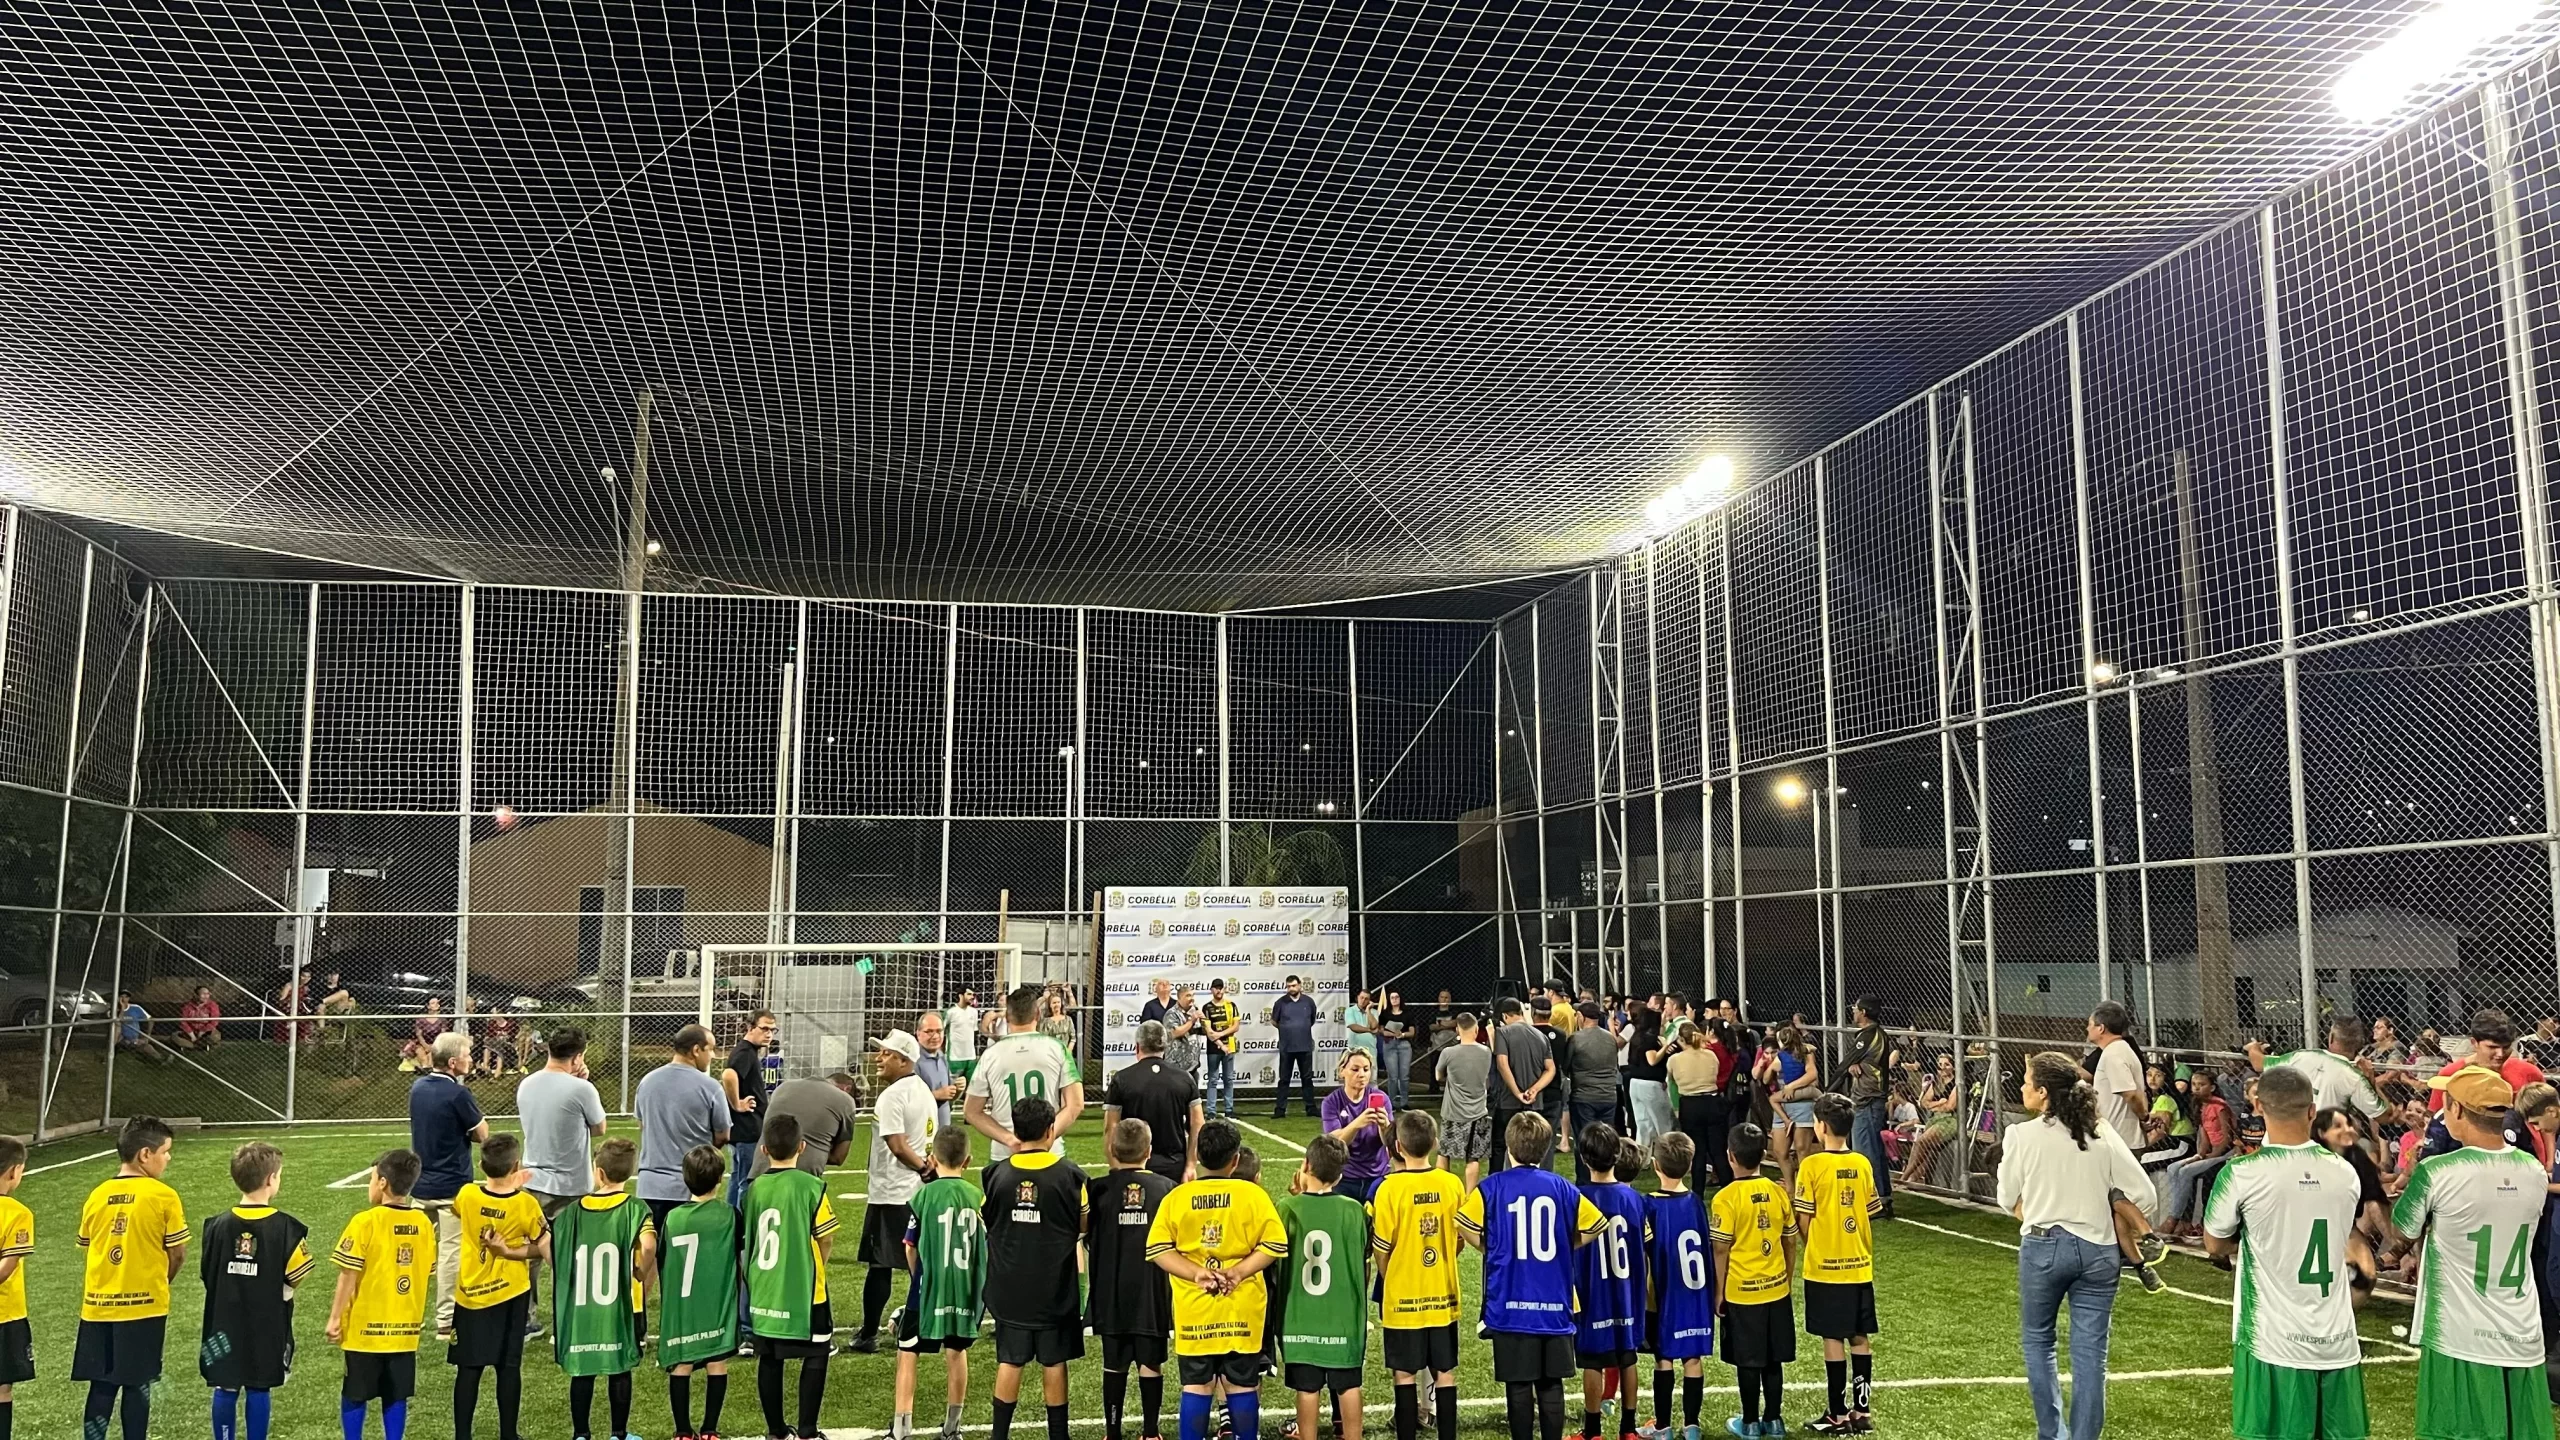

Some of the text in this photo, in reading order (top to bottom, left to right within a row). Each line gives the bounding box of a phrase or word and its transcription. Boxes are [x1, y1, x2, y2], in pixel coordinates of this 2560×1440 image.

[1128, 894, 1176, 904] CORBÉLIA
[1203, 894, 1251, 904] CORBÉLIA
[1278, 893, 1325, 904] CORBÉLIA
[1104, 922, 1140, 932] RBÉLIA
[1168, 922, 1216, 932] CORBÉLIA
[1243, 922, 1291, 932] CORBÉLIA
[1127, 952, 1176, 963] CORBÉLIA
[1203, 952, 1251, 962] CORBÉLIA
[1278, 951, 1325, 961] CORBÉLIA
[1118, 1211, 1148, 1226] CORBÉLIA
[1507, 1195, 1557, 1262] 10
[758, 1208, 781, 1271] 6
[937, 1206, 978, 1270] 13
[1597, 1214, 1630, 1280] 16
[575, 1242, 620, 1307] 10
[671, 1232, 699, 1298] 7
[1301, 1229, 1332, 1296] 8
[1677, 1229, 1706, 1291] 6
[2298, 1218, 2334, 1298] 4
[2466, 1223, 2530, 1299] 14
